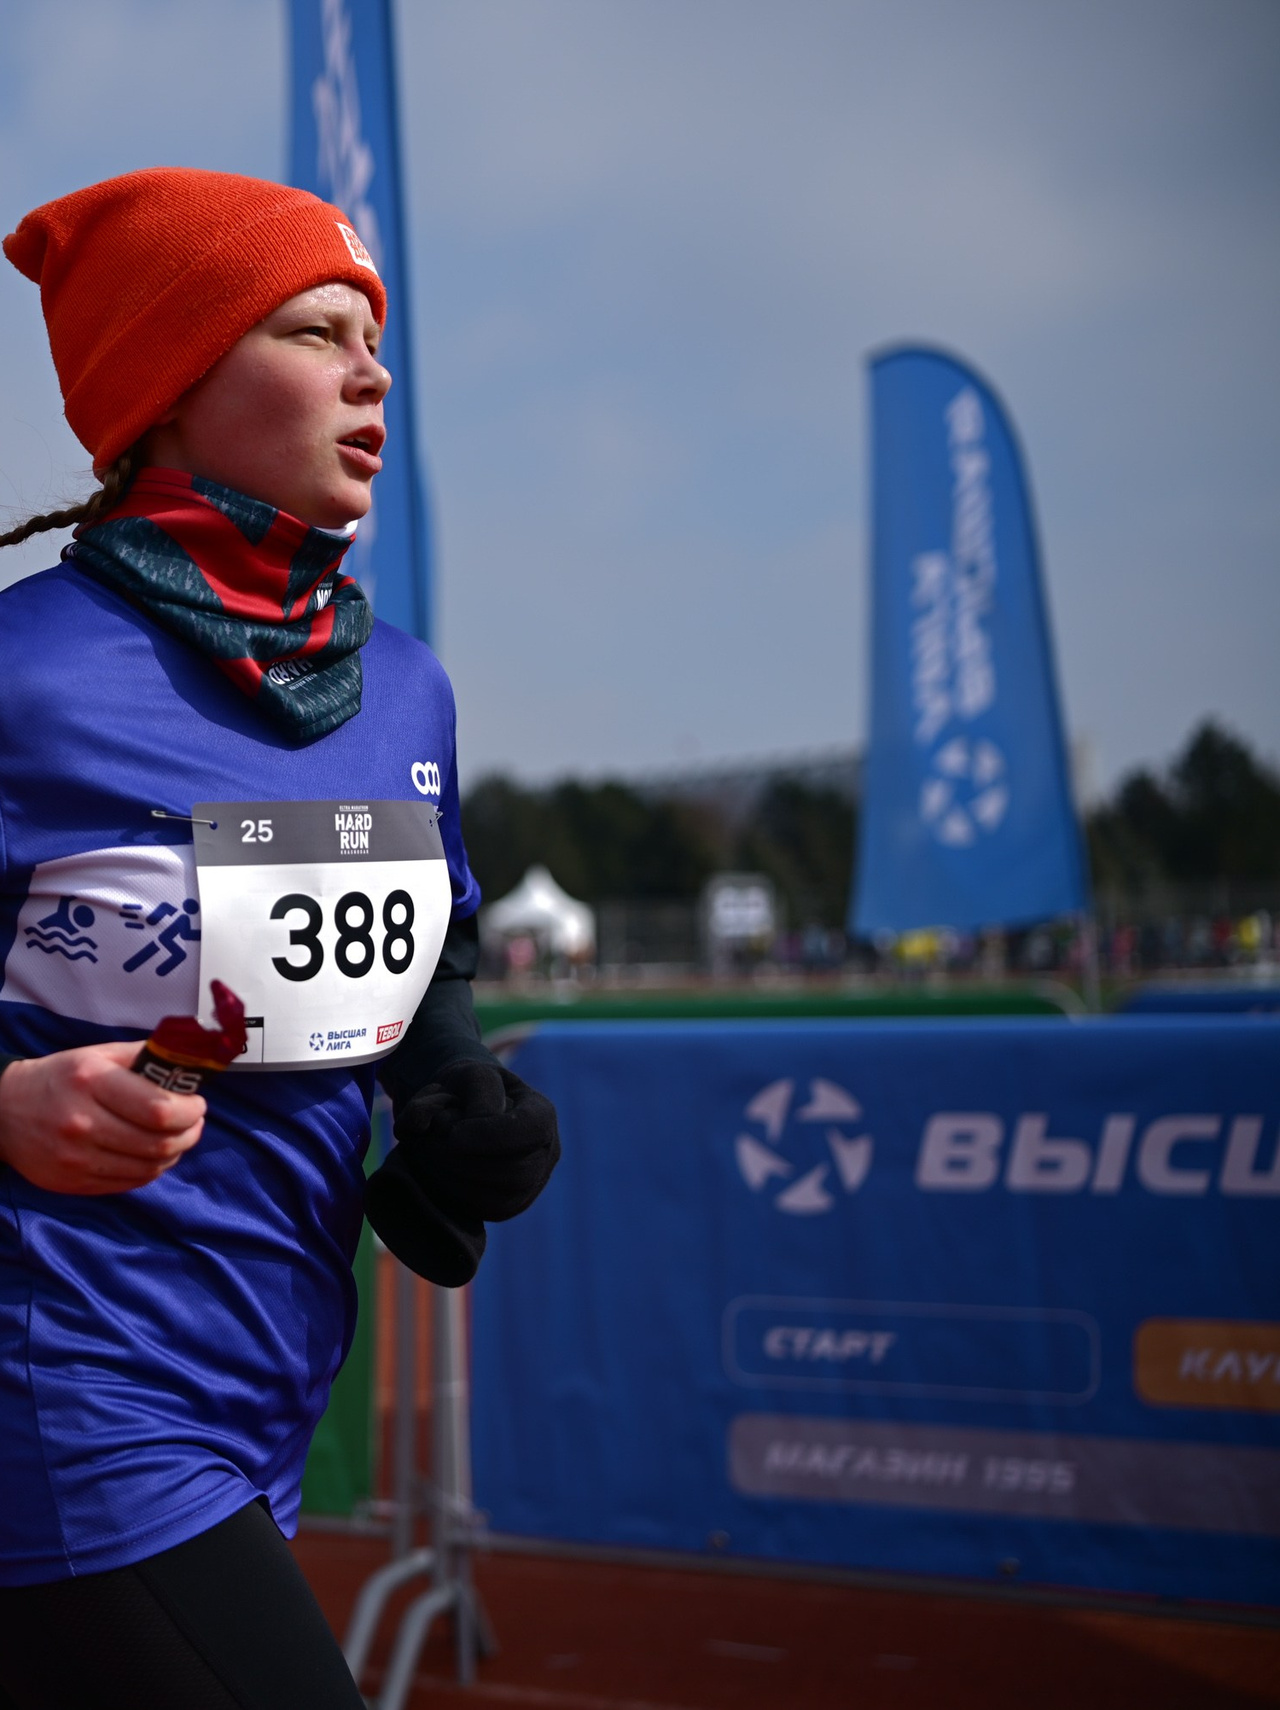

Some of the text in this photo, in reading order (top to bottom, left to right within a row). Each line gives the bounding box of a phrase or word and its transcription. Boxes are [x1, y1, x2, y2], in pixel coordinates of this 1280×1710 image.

[240, 819, 273, 843] 25
[334, 813, 372, 831] HARD
[340, 831, 369, 849] RUN
[270, 889, 415, 982] 388
[326, 1040, 352, 1051] ЛИГА
[327, 1028, 367, 1040] ВЫСШАЯ
[763, 1325, 898, 1365] СТАРТ
[1178, 1347, 1280, 1384] КЛУ
[763, 1441, 969, 1486] МАГАЗИН
